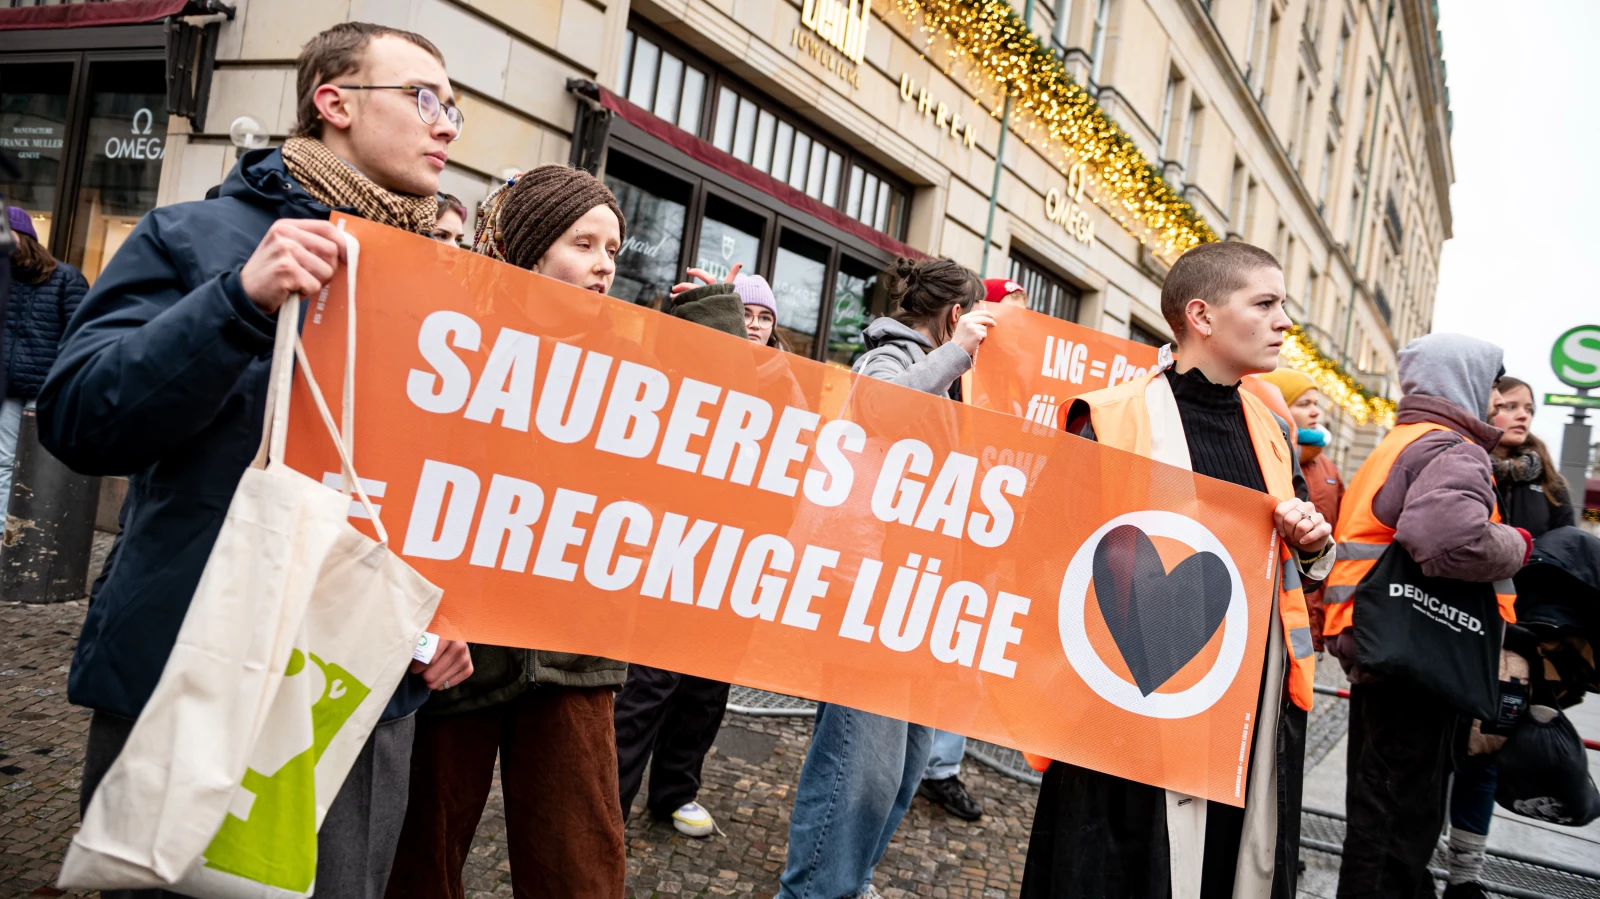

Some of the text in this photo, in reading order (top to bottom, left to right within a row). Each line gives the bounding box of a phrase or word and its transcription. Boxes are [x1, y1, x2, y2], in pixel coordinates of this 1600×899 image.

[790, 27, 862, 91] JUWELIERE
[899, 71, 978, 150] UHREN
[32, 139, 64, 149] MULLER
[1045, 187, 1096, 249] OMEGA
[1041, 335, 1088, 385] LNG
[1089, 359, 1107, 379] =
[1562, 329, 1600, 383] S
[407, 311, 1028, 549] SAUBERES GAS
[402, 460, 841, 631] DRECKIGE
[838, 552, 1032, 679] LÜGE
[1389, 583, 1485, 636] DEDICATED.
